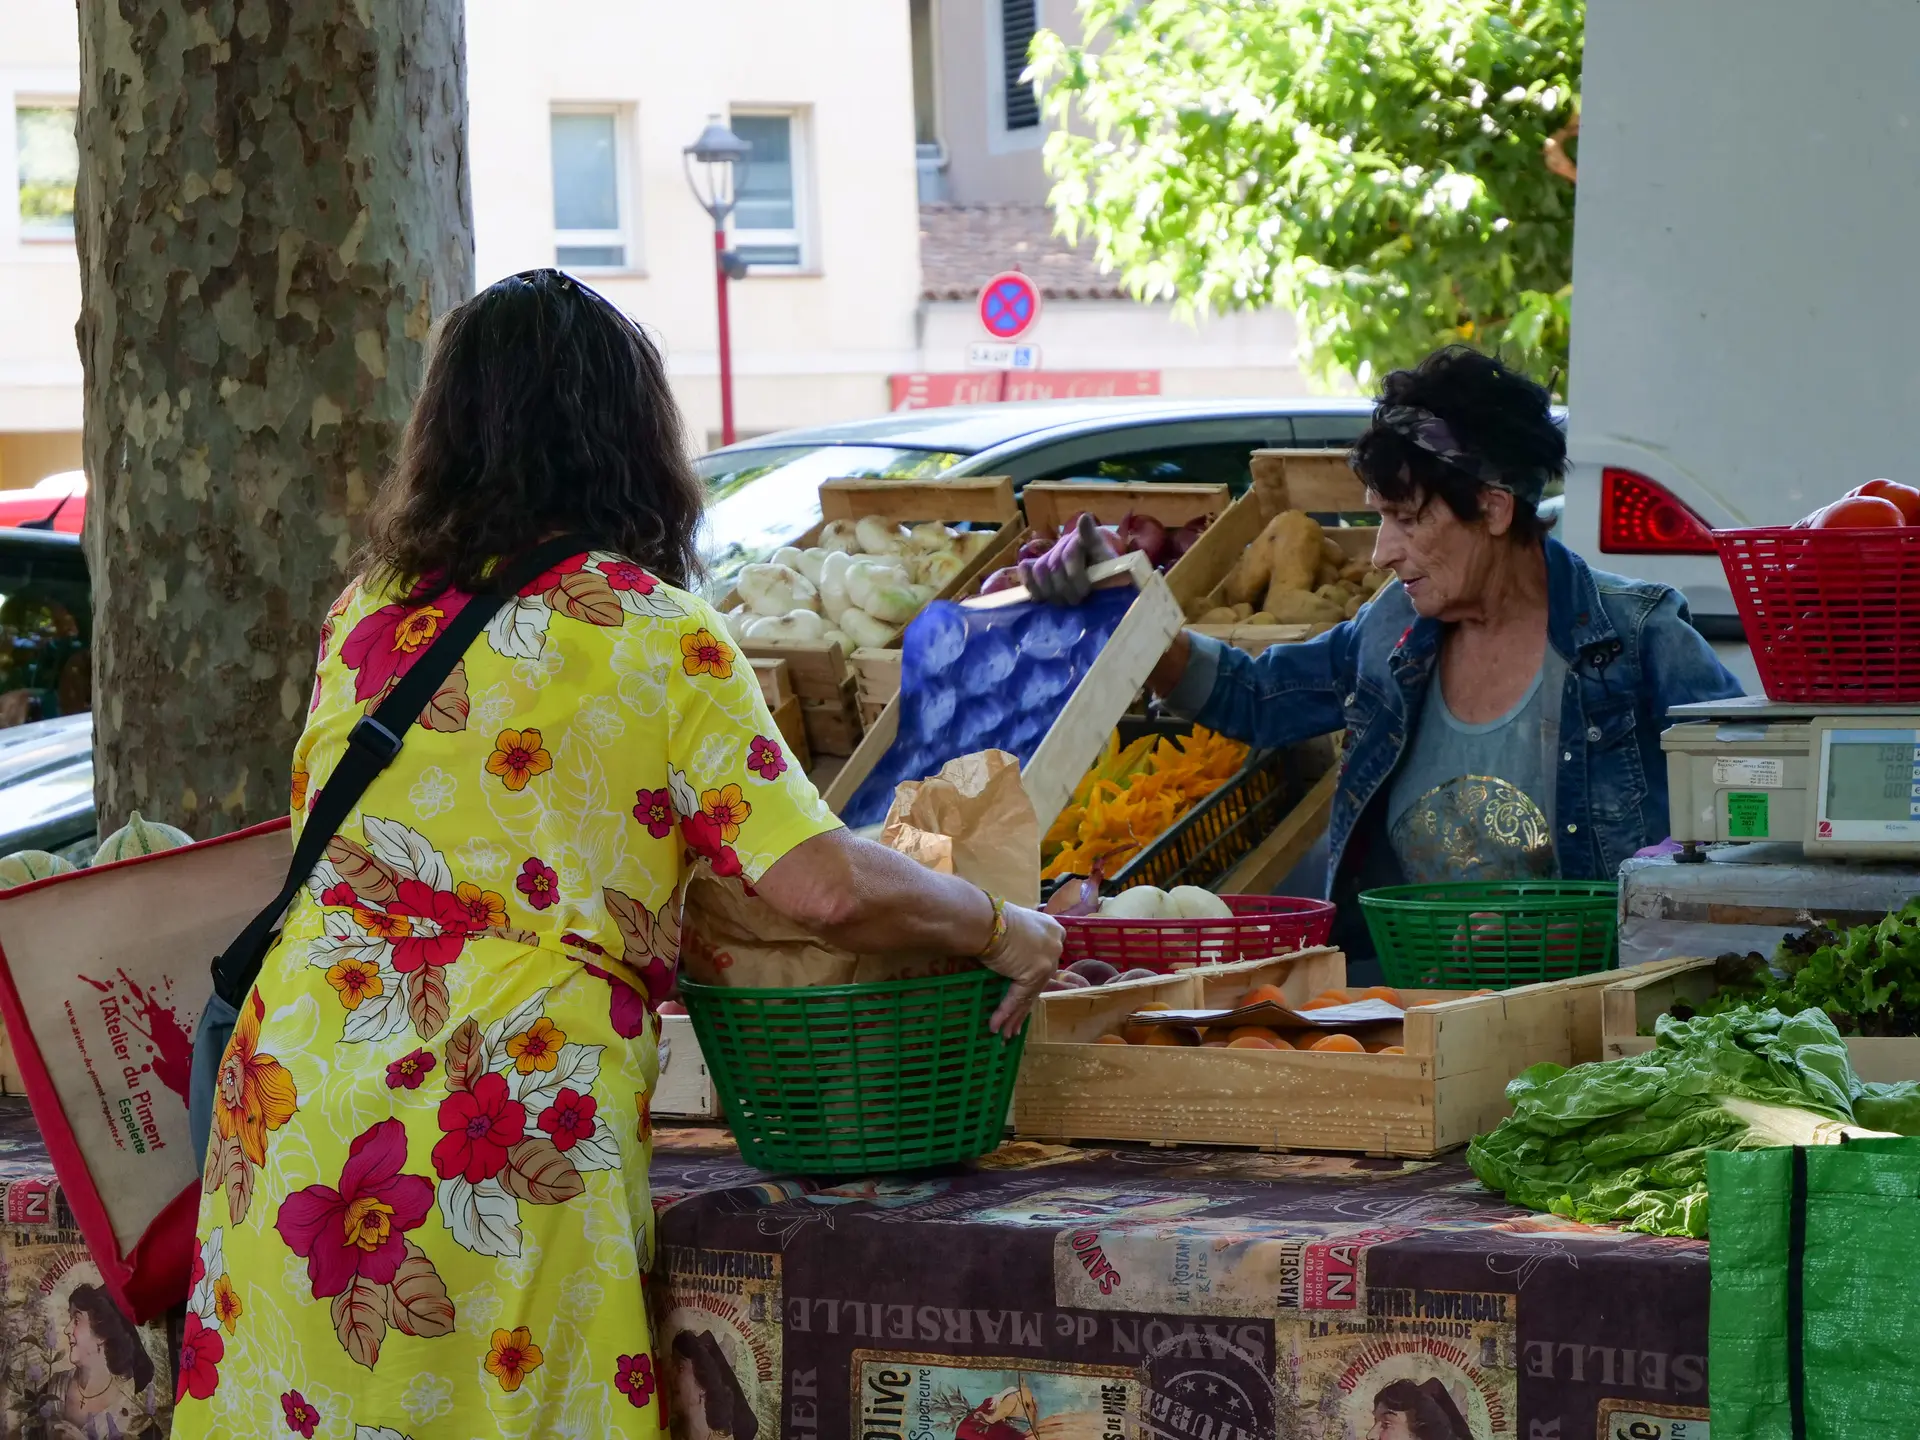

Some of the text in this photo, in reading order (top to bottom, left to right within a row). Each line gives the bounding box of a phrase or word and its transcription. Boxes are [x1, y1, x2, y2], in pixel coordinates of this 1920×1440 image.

[97, 995, 167, 1152] l'Atelier du Piment
[118, 1097, 147, 1155] Espelette
[39, 1250, 76, 1296] SUPERIEUR
[691, 1277, 744, 1296] LIQUIDE
[1304, 1251, 1314, 1301] SUR TOUT
[1314, 1259, 1324, 1306] MORCEAU
[698, 1294, 739, 1320] PRODUIT
[735, 1319, 753, 1340] BASE
[787, 1296, 1268, 1360] SAVON de MARSEILLE
[1411, 1320, 1472, 1340] LIQUIDE
[1338, 1341, 1395, 1394] SUPERIEUR
[1401, 1340, 1421, 1354] TOUT
[1421, 1337, 1468, 1368] PRODUIT
[1466, 1366, 1486, 1387] BASE
[1523, 1340, 1708, 1394] SEILLE
[1107, 1417, 1121, 1431] DE
